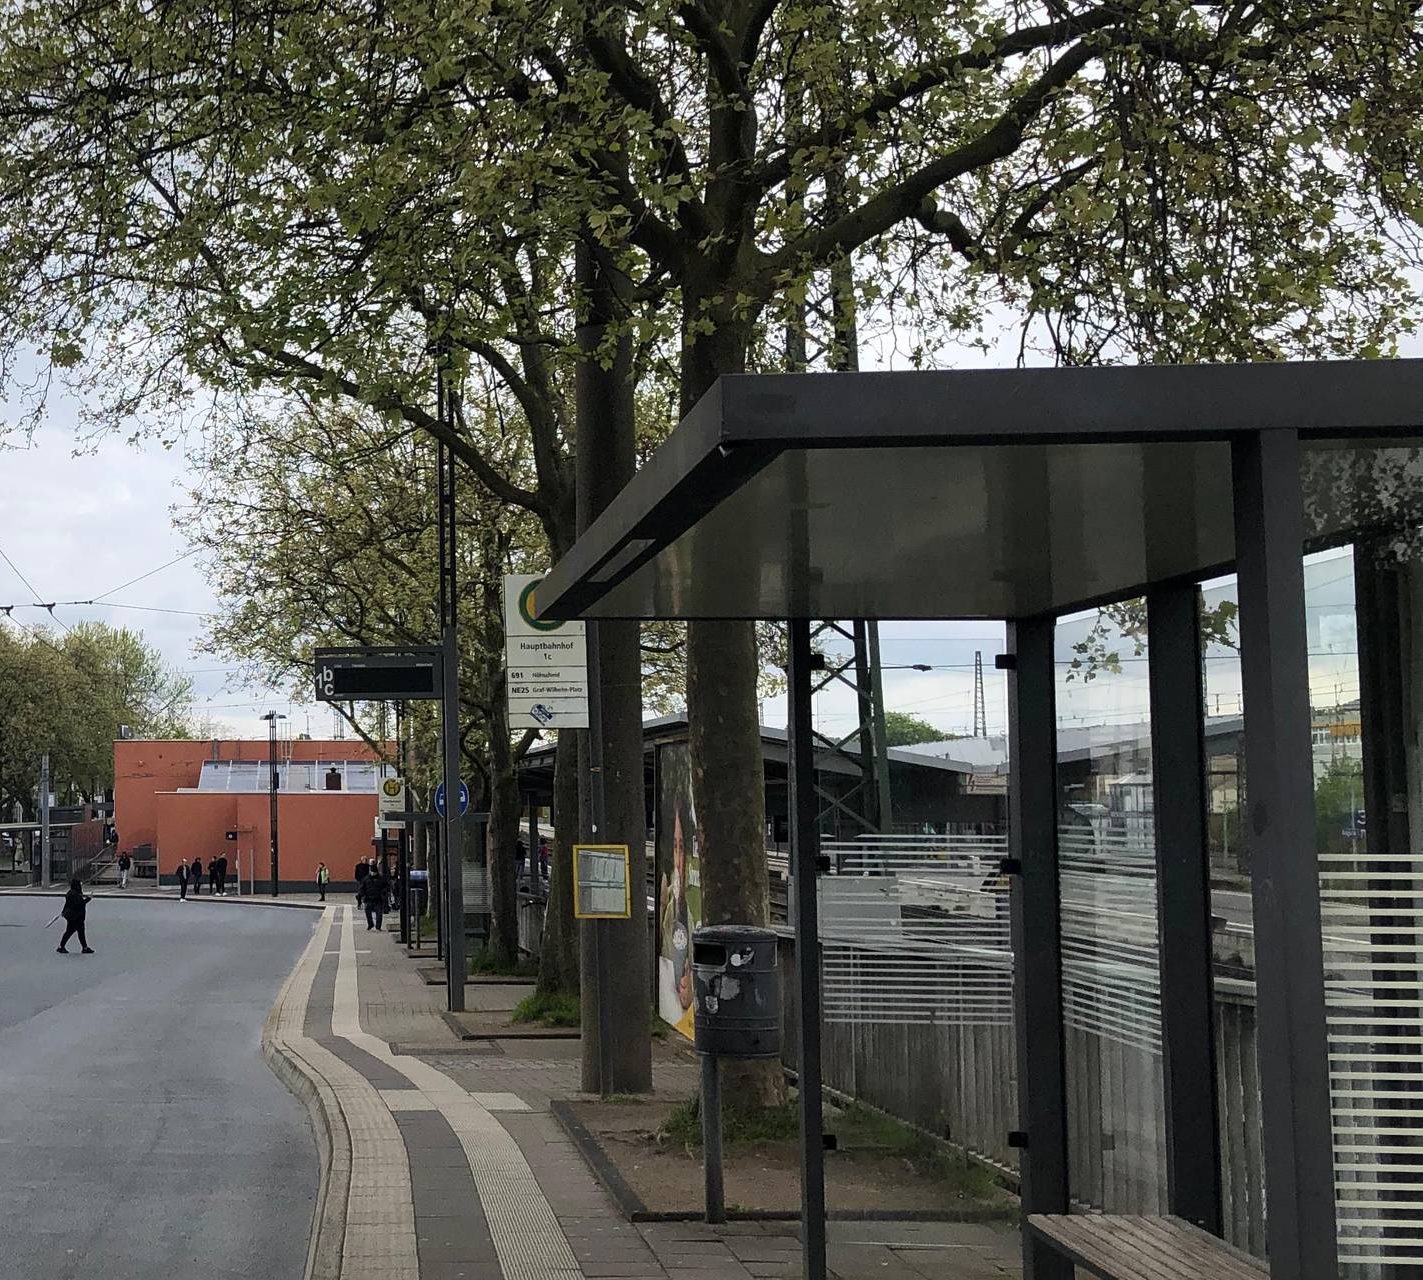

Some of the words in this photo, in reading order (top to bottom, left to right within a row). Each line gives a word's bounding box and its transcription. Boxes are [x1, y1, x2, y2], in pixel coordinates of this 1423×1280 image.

[520, 642, 574, 651] Hauptbahnhof
[323, 666, 333, 681] b
[316, 673, 322, 688] 1
[325, 684, 334, 695] c
